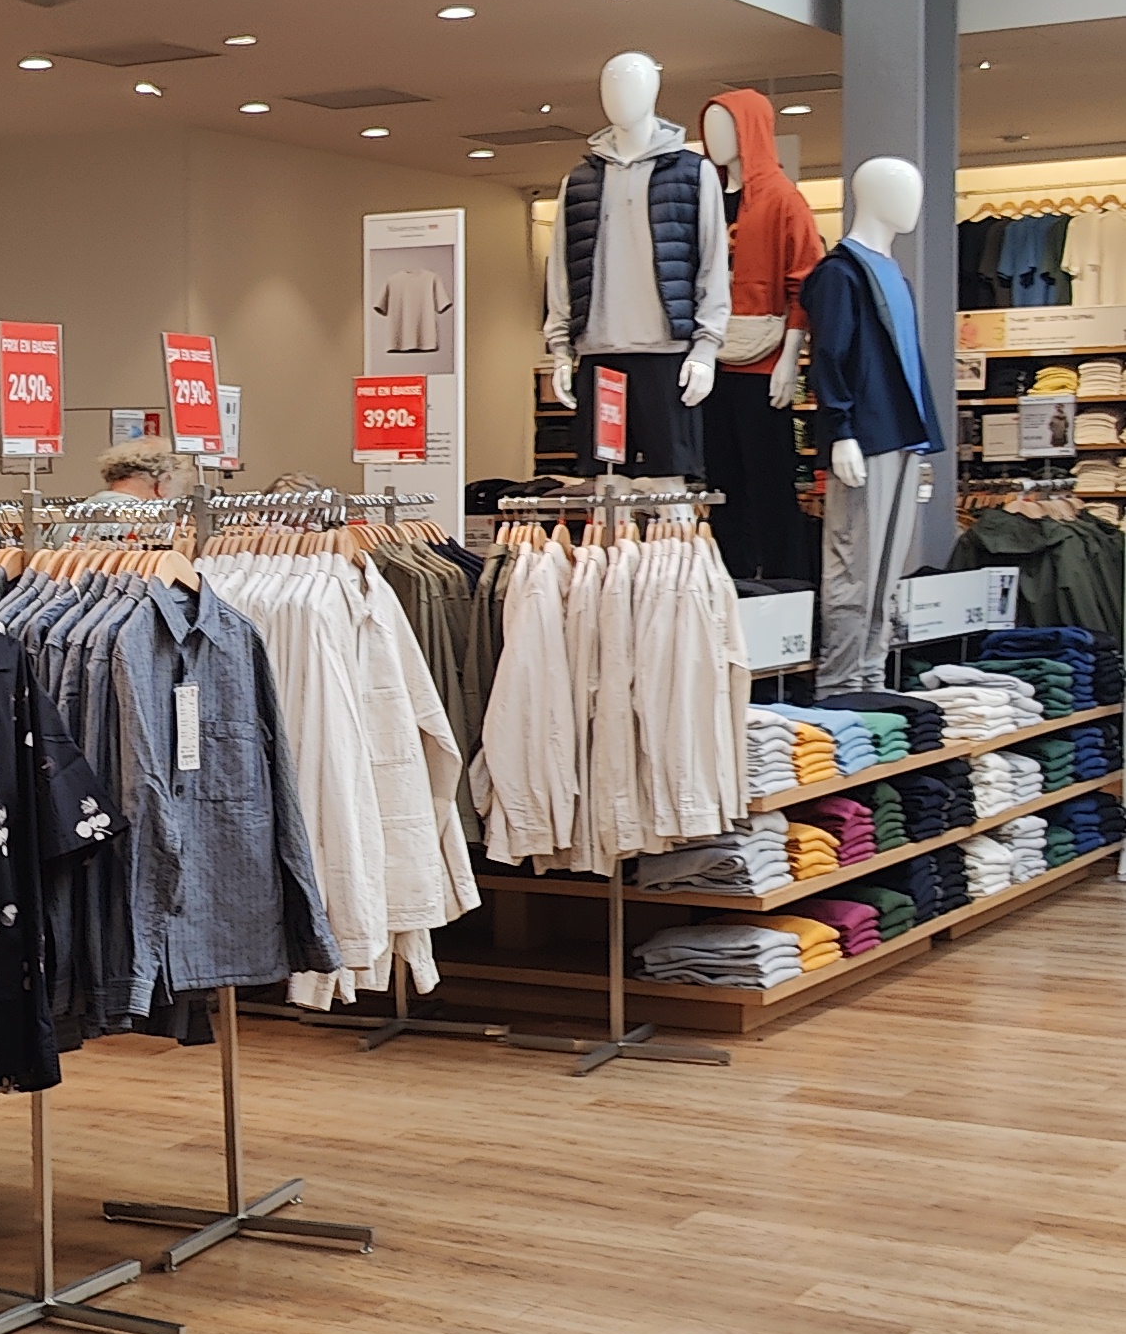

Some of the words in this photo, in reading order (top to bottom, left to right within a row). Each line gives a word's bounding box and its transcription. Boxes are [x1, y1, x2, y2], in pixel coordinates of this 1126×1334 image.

[2, 338, 19, 353] PRIX
[19, 339, 31, 353] EN
[31, 340, 57, 355] BAISSE
[8, 373, 54, 405] 24,90€
[174, 378, 212, 406] 29,90€
[356, 386, 376, 397] PRIX
[377, 386, 391, 396] EN
[391, 385, 422, 396] BAISSE
[363, 408, 416, 429] 39,90€
